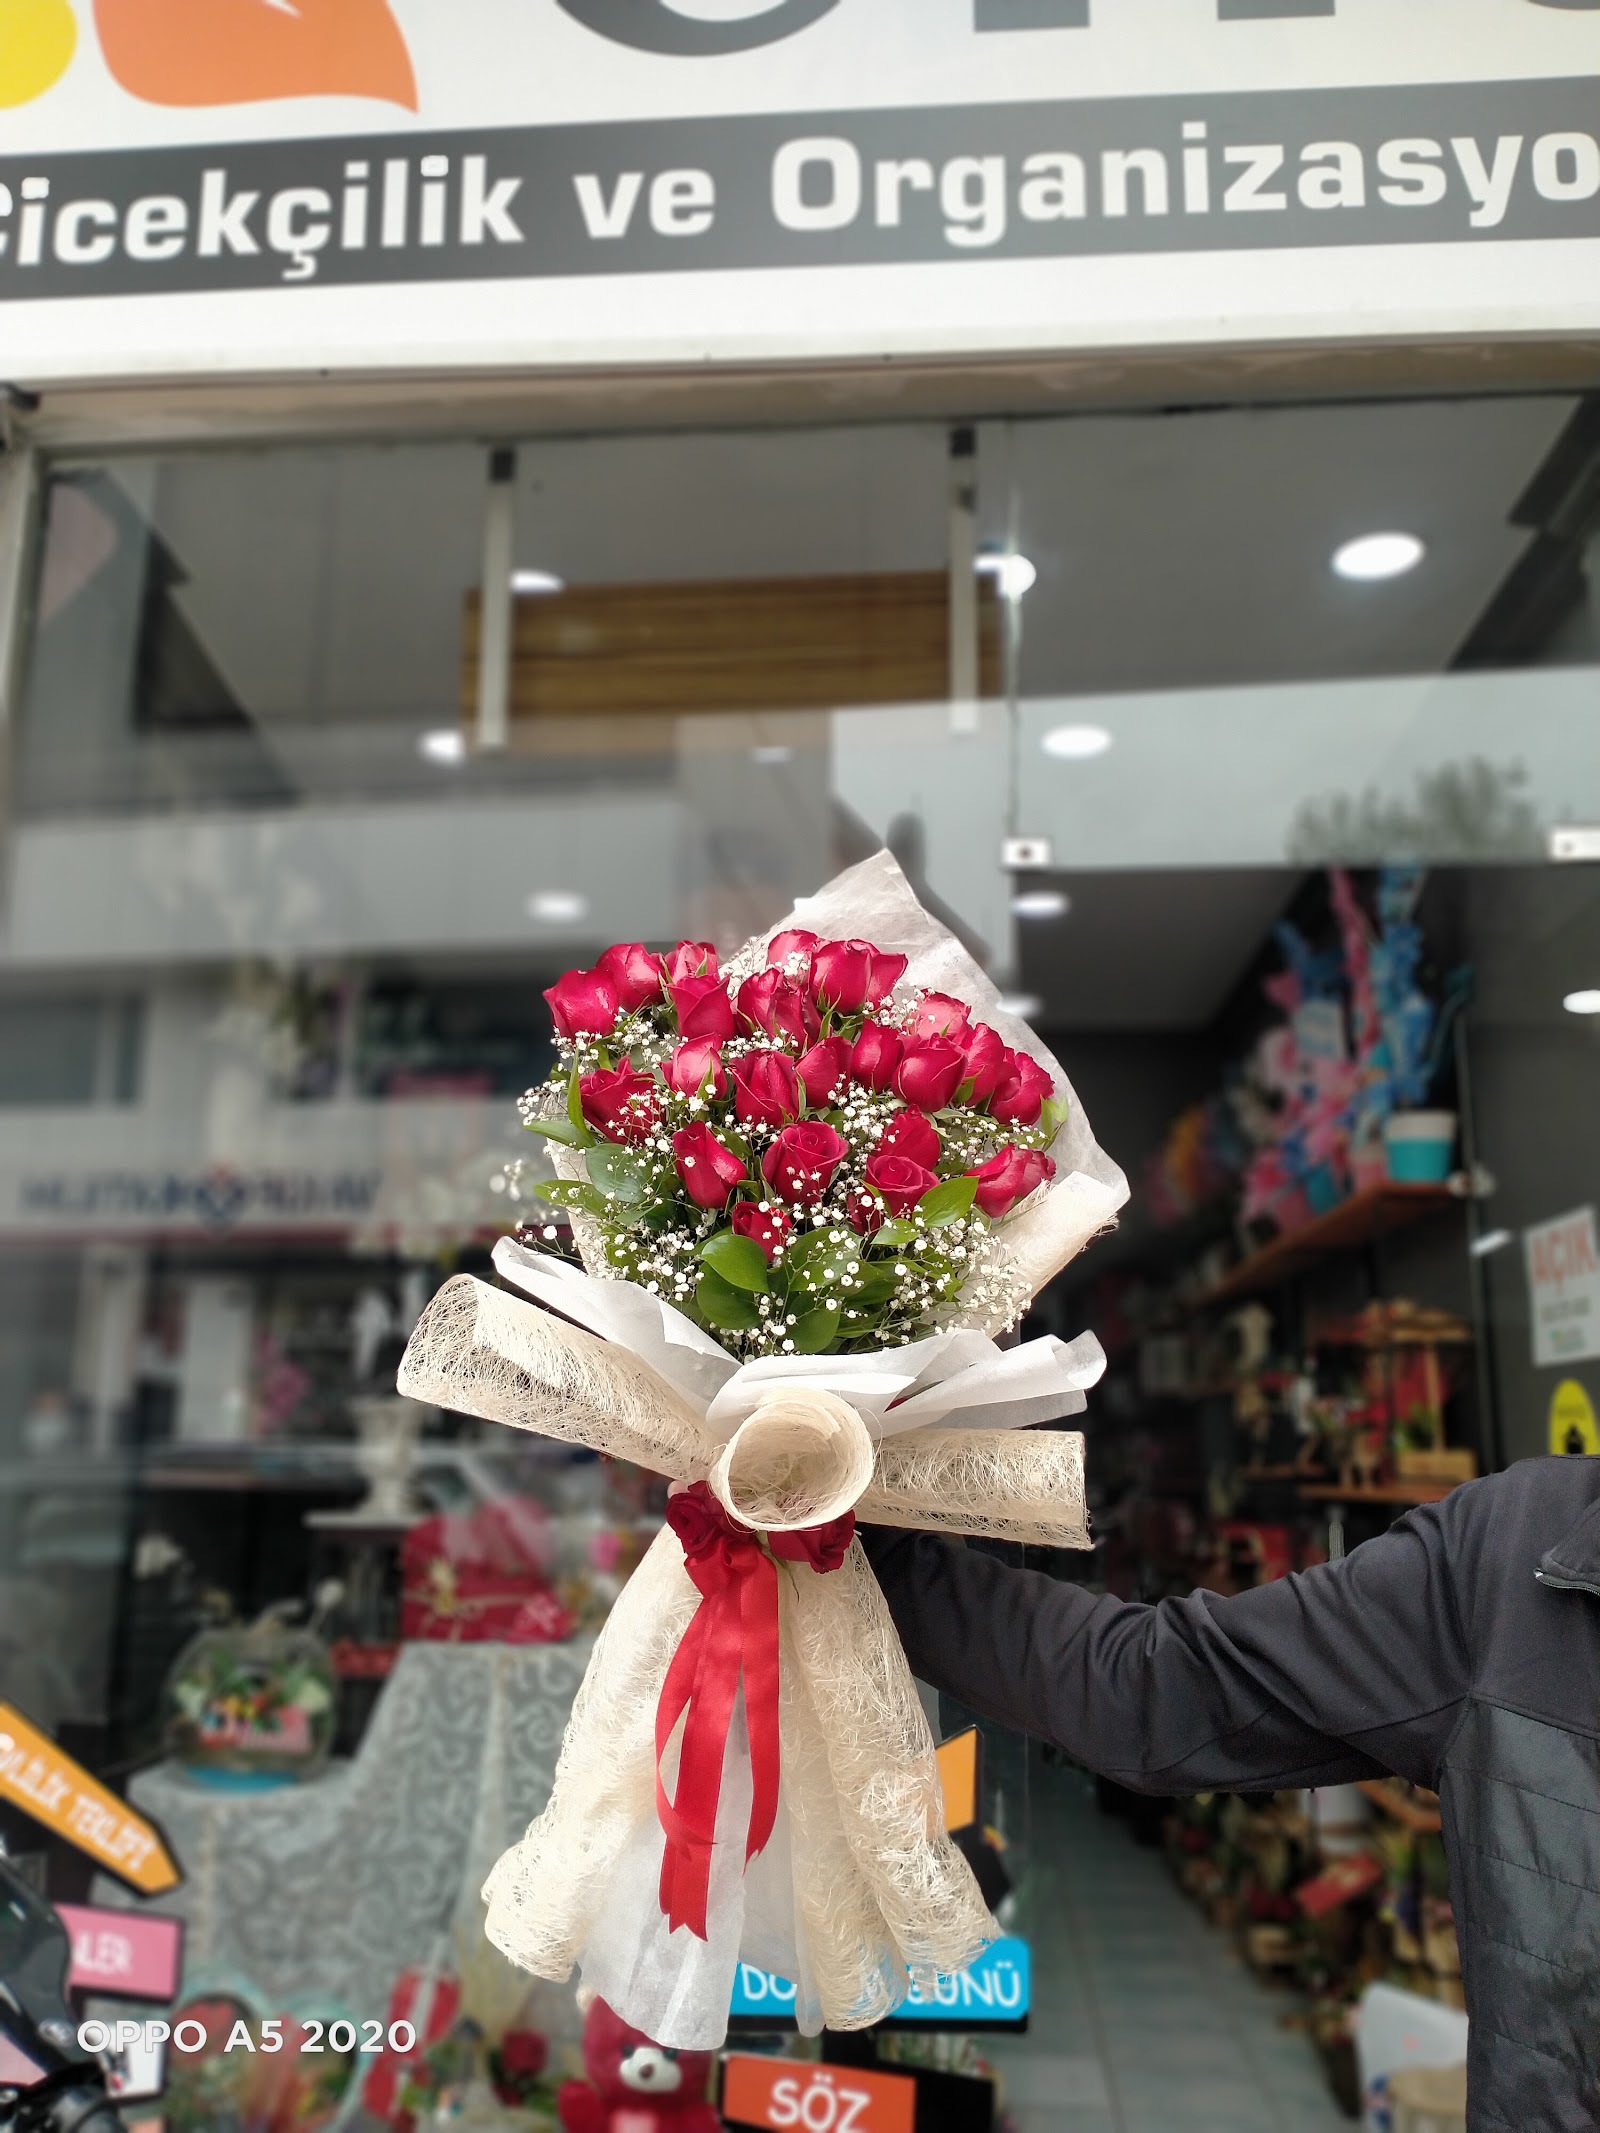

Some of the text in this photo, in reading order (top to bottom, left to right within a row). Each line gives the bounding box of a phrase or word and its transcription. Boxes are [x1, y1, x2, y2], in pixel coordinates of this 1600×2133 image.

[0, 121, 1600, 280] icekçilik ve Organizasyo
[768, 2070, 872, 2133] SÖZ
